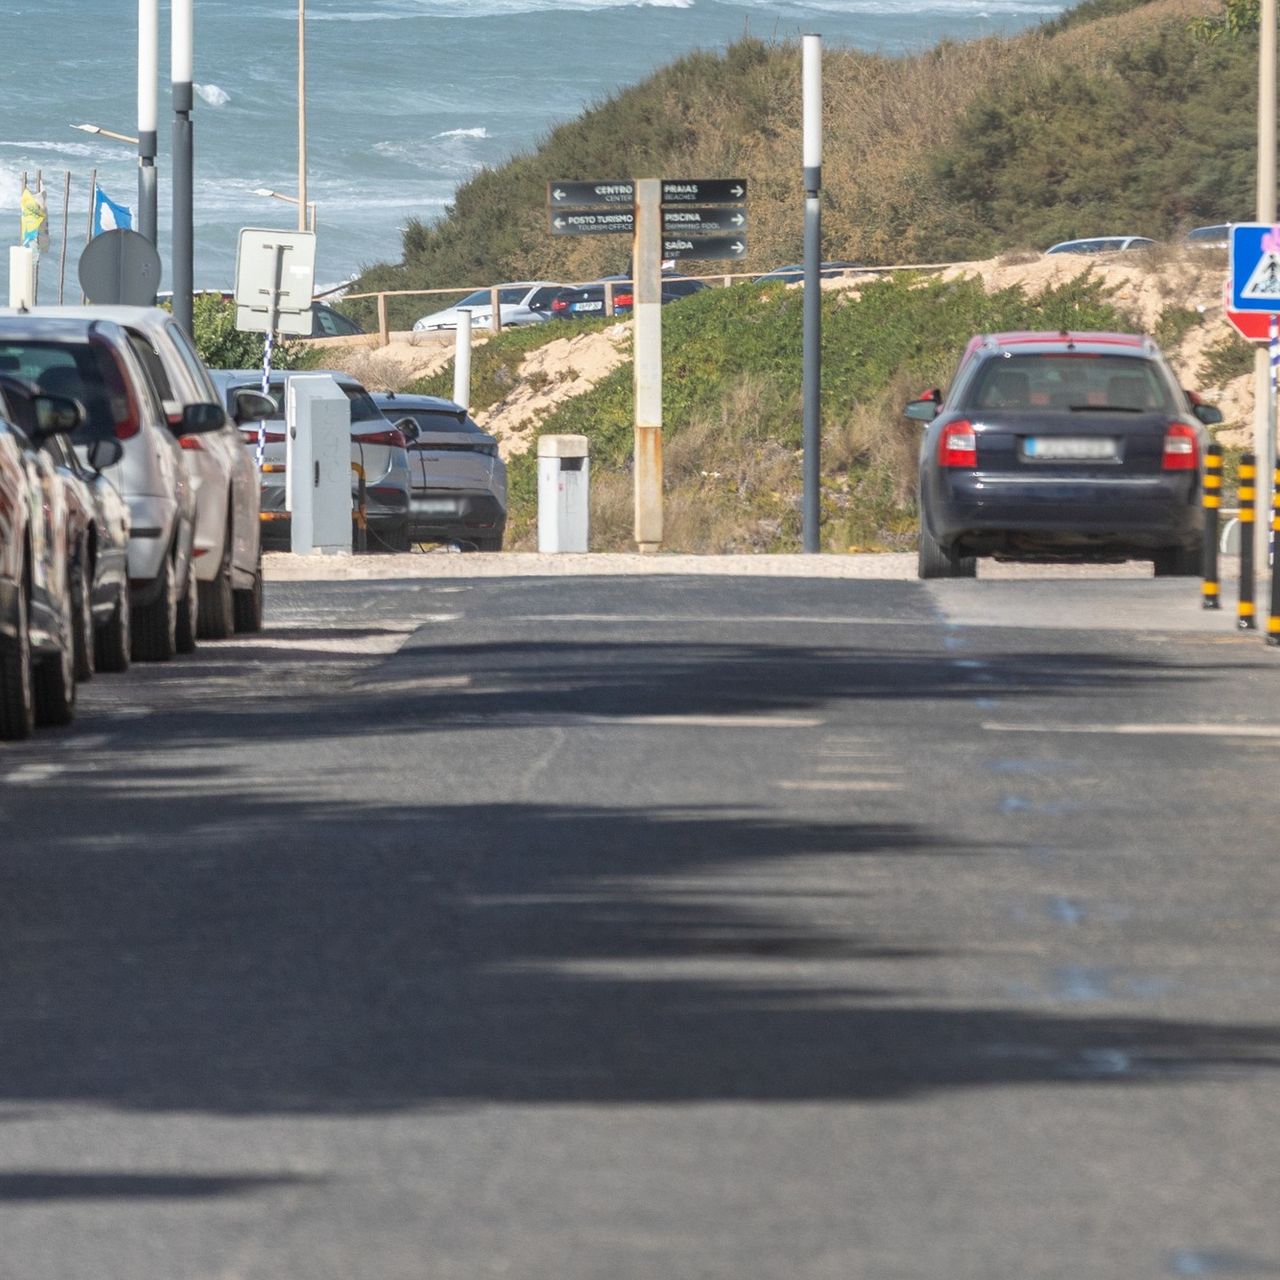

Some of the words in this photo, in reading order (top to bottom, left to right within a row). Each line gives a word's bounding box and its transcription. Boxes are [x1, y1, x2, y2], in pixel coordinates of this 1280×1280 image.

[595, 185, 633, 195] CENTRO
[664, 184, 698, 193] PRAIAS
[568, 216, 596, 225] POSTO
[596, 214, 633, 224] TURISMO
[664, 213, 701, 221] PISCINA
[664, 239, 693, 249] SAÍDA
